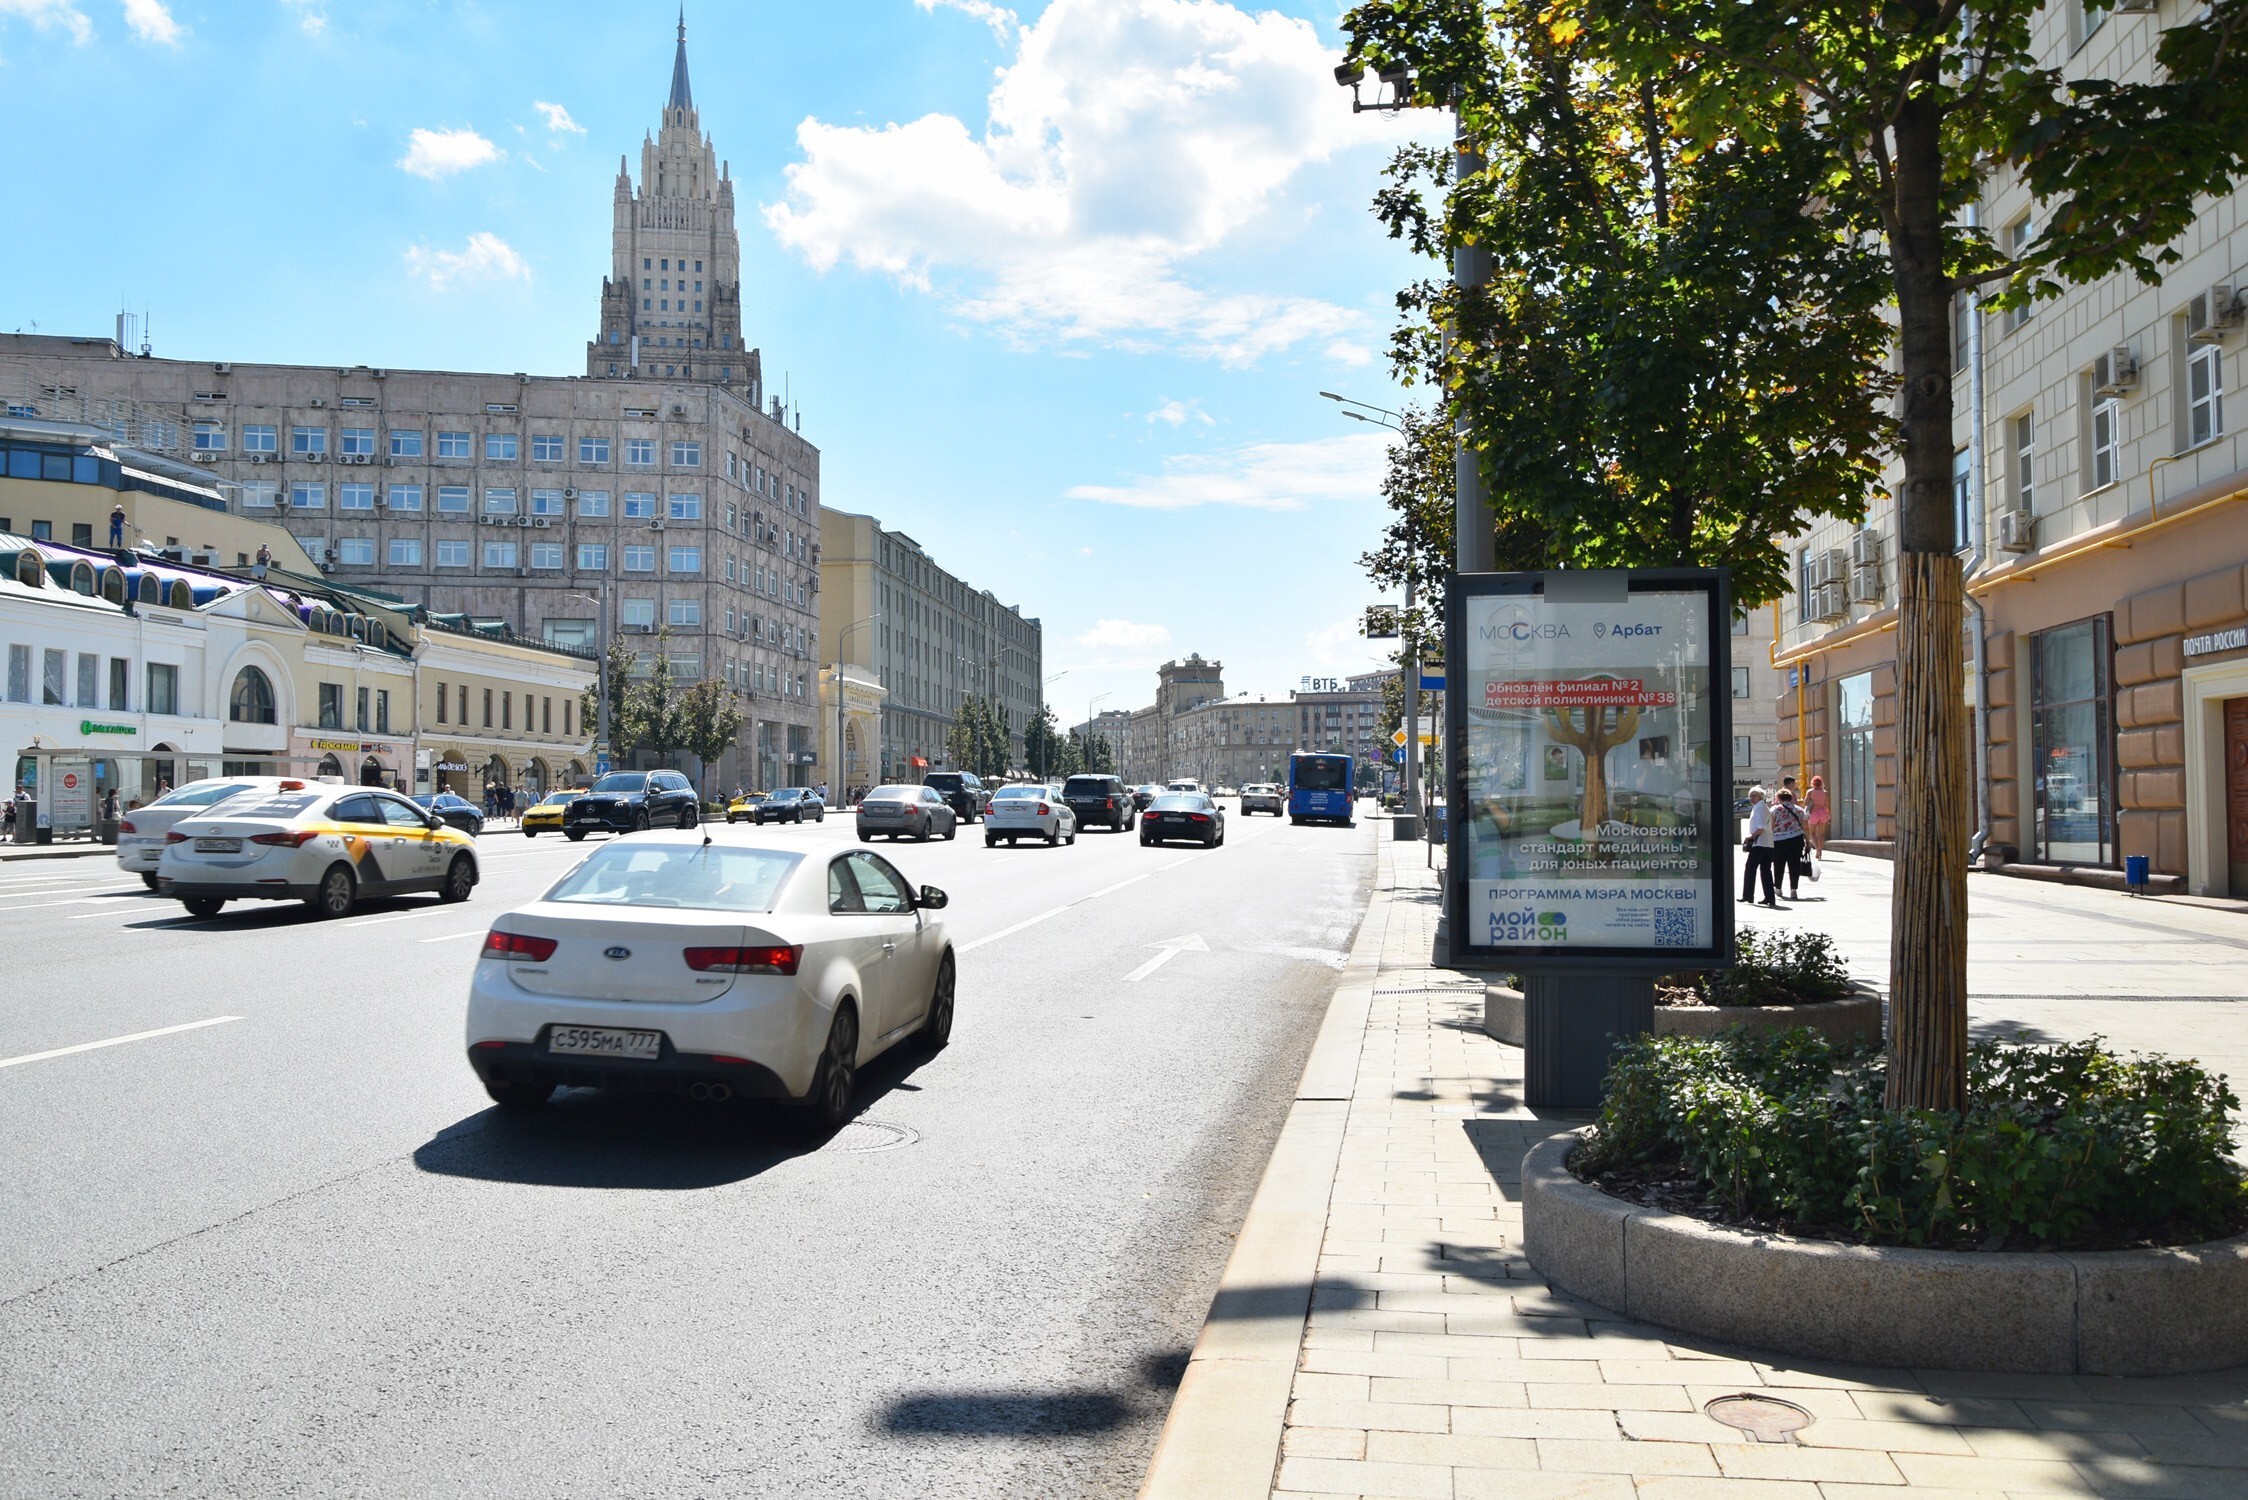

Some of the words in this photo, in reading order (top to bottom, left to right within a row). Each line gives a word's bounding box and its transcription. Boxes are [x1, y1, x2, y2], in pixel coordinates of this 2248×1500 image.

[1480, 622, 1571, 641] МОСКВА
[1611, 623, 1662, 639] Арбат
[2183, 635, 2211, 656] ПОЧТА
[2213, 628, 2246, 651] РОССИИ
[1313, 678, 1338, 690] ВТБ
[1486, 681, 1554, 694] Обновлён
[1556, 680, 1609, 694] филиал
[1486, 694, 1541, 707] детской
[1544, 694, 1635, 705] поликлиники
[1595, 824, 1697, 837] Московский
[1520, 843, 1594, 855] стандарт
[1599, 843, 1683, 855] медицины
[1529, 860, 1559, 871] для
[1562, 860, 1607, 870] юных
[1612, 859, 1698, 871] пациентов
[1489, 889, 1581, 900] ПРОГРАММА
[1585, 889, 1626, 900] МЭРА
[1631, 888, 1697, 900] МОСКВЫ
[1489, 907, 1535, 926] мой
